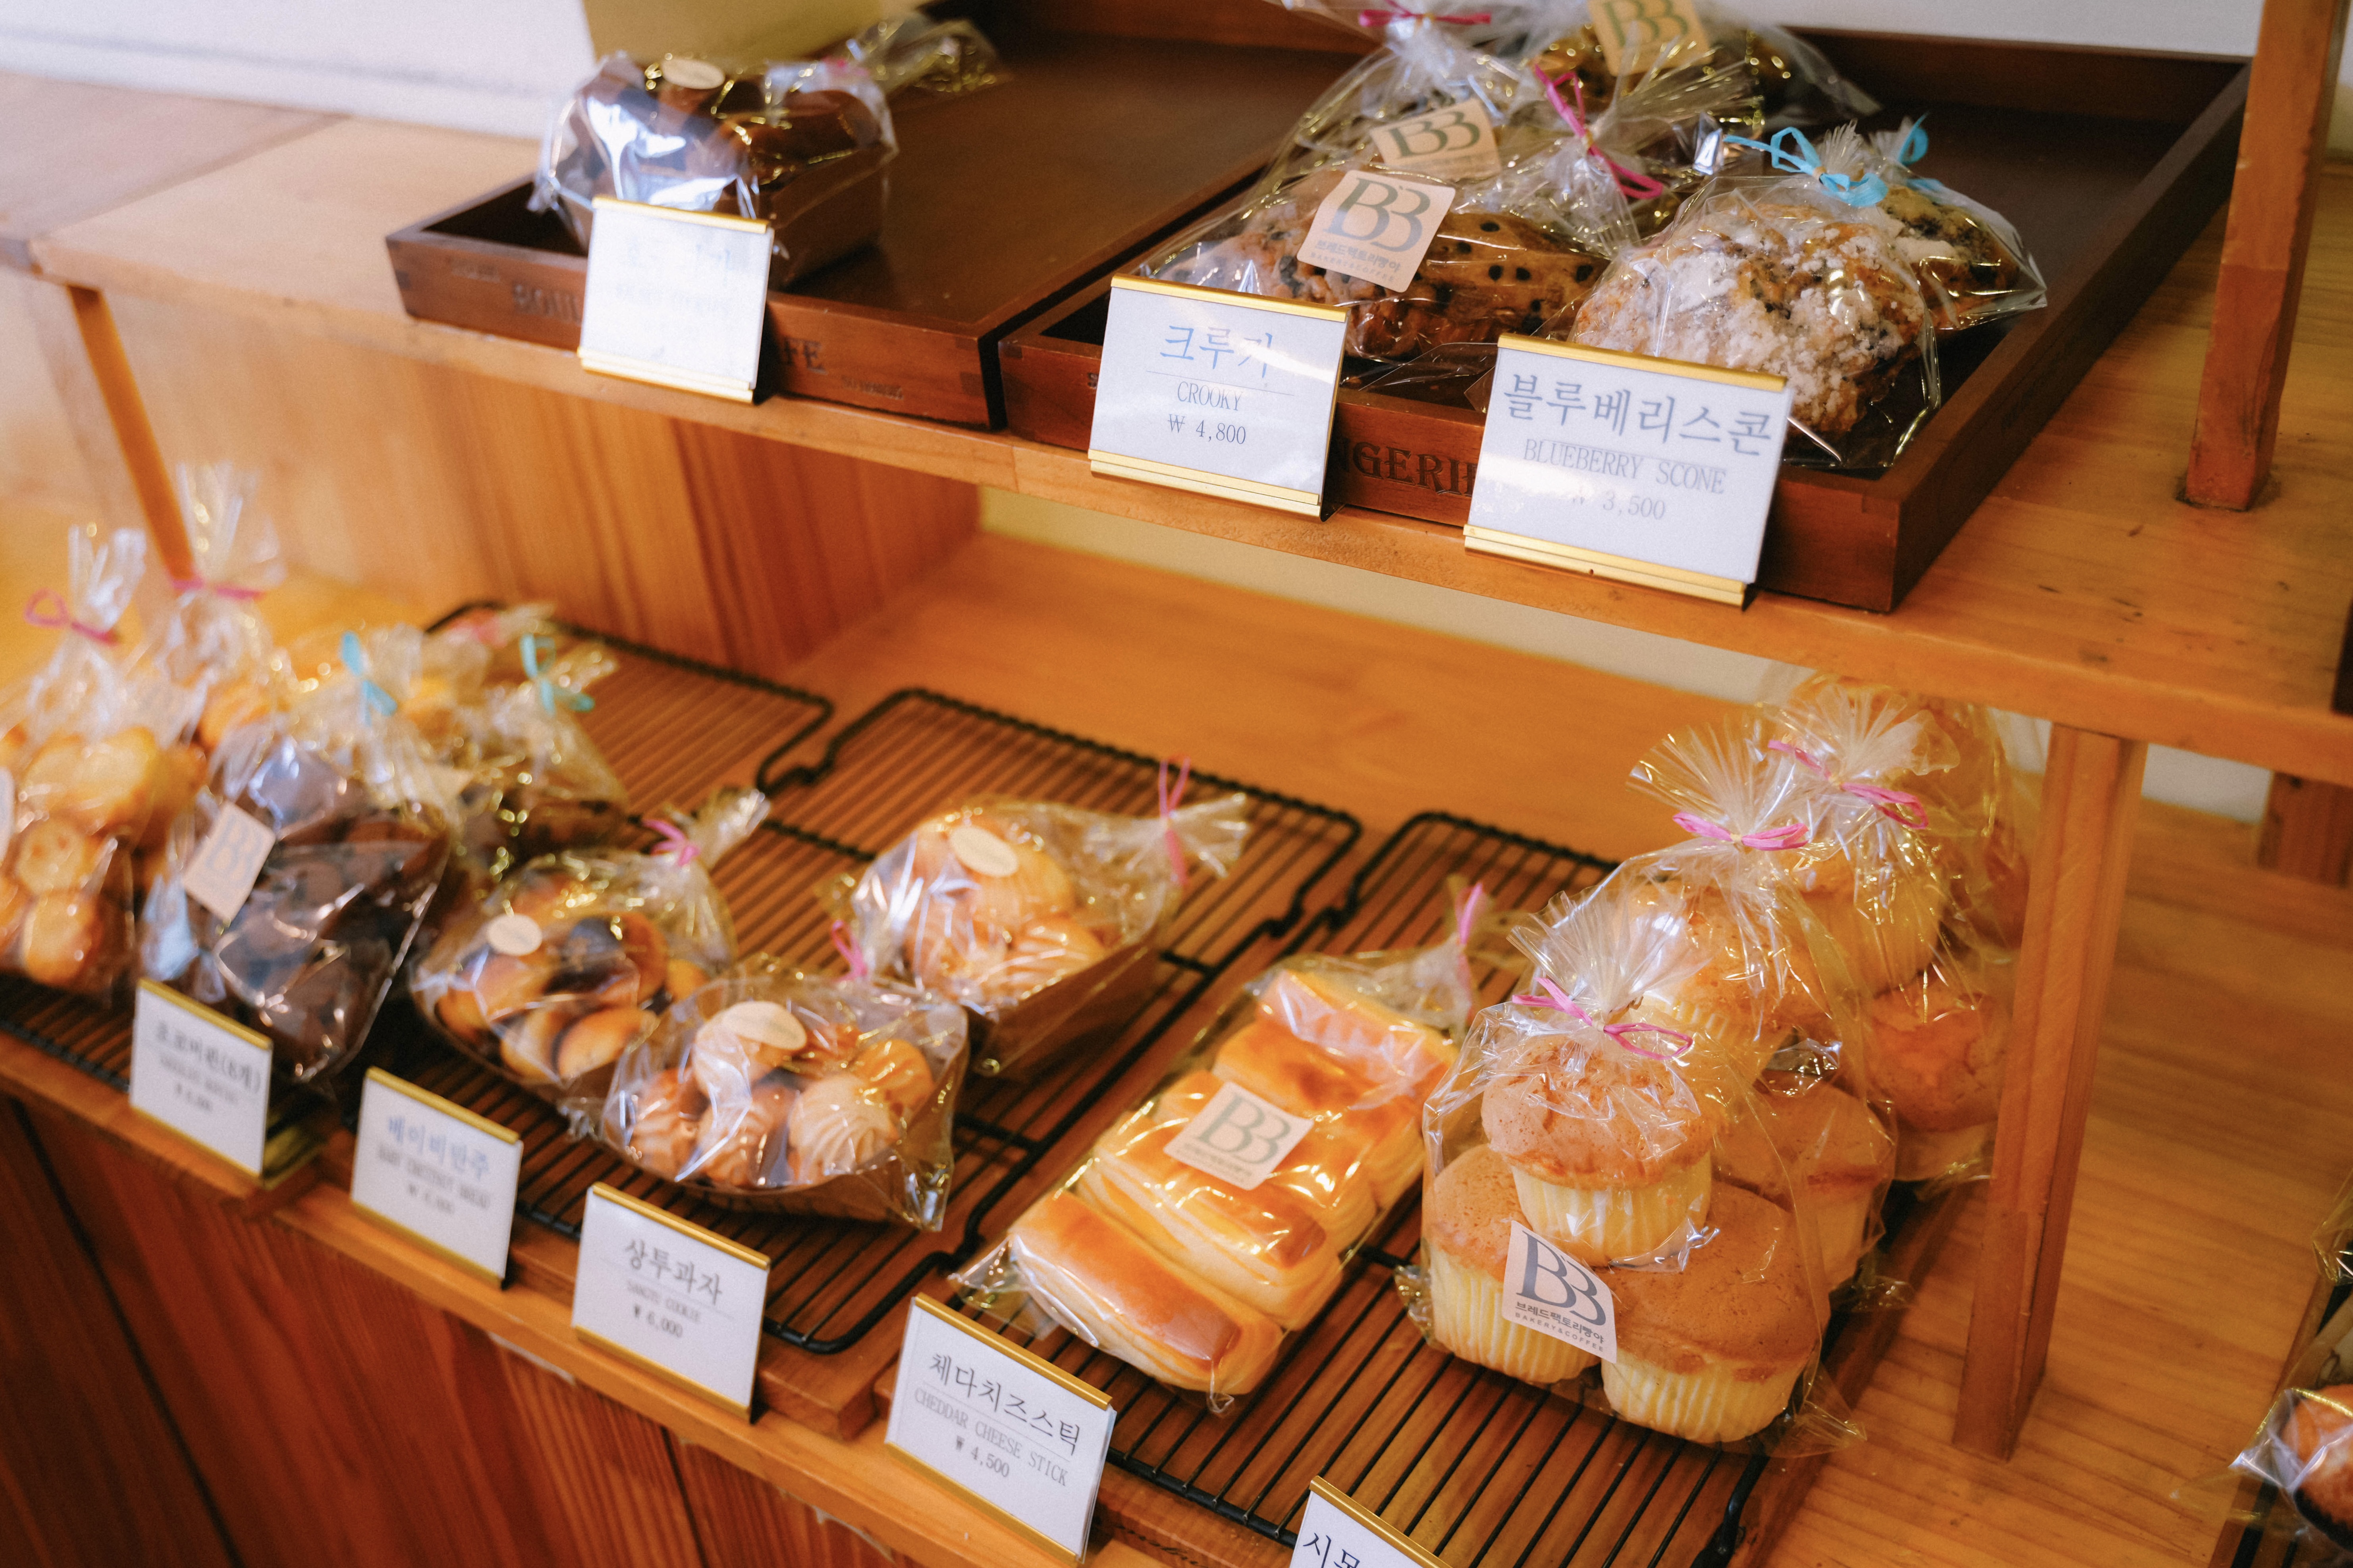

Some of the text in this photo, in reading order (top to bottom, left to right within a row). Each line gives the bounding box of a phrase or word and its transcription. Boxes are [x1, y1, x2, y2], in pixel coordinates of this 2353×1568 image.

[1177, 381, 1244, 411] CROOKY
[1504, 374, 1771, 456] 블루베리스콘
[1196, 419, 1246, 444] 4,800
[1524, 439, 1727, 494] BLUEBERRY SCONE
[1602, 489, 1666, 520] 3,500
[625, 1239, 722, 1306] 상투과자
[1515, 1302, 1604, 1344] 브레드팩토리빵야
[929, 1352, 1079, 1456] 체다치즈스틱
[915, 1388, 1068, 1486] CHEDDAR CHEESE STICK
[971, 1447, 1009, 1477] 4,500
